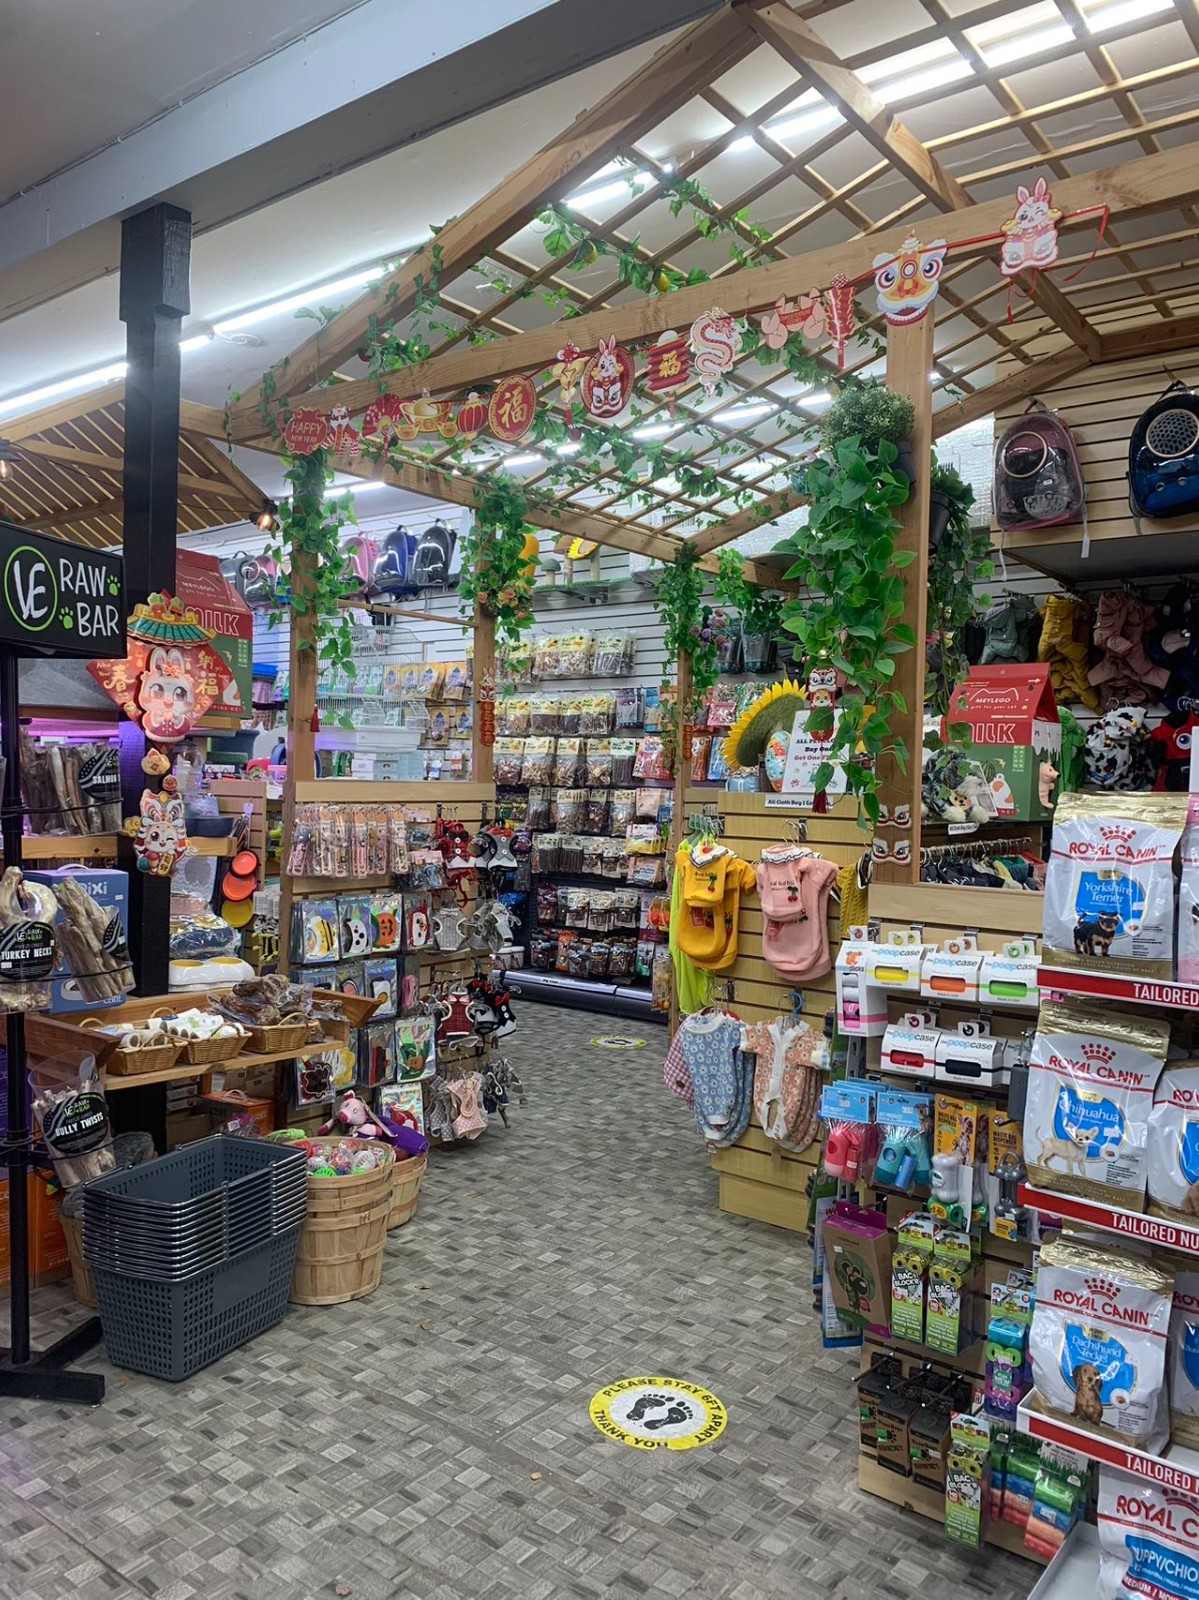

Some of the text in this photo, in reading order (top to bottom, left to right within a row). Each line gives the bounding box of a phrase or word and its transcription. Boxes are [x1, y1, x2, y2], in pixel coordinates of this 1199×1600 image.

[498, 390, 524, 428] 福
[291, 421, 322, 435] HAPPY
[60, 558, 106, 597] RAW
[76, 602, 119, 637] BAR
[103, 664, 135, 692] 春
[1069, 842, 1158, 859] ROYAL CANIN
[1084, 881, 1133, 895] Yorkshire
[0, 947, 52, 960] TURKEY NECKS
[933, 957, 978, 969] poopcase
[1133, 983, 1199, 1006] TAILORED
[893, 1030, 935, 1043] poopcase
[947, 1039, 993, 1051] poopcase
[1049, 1055, 1143, 1086] ROYAL CANIN
[1060, 1100, 1119, 1121] Chihuahua
[55, 1112, 104, 1137] BULLY TWISTS
[1112, 1213, 1176, 1243] TAILORED
[1054, 1289, 1150, 1325] ROYAL CANIN
[1072, 1336, 1121, 1357] Dachshund
[1081, 1346, 1109, 1363] Teckel
[602, 1378, 723, 1443] PLEASE STAY 6FT APART
[593, 1410, 627, 1441] THANK
[1125, 1453, 1191, 1489] TAILORED
[1117, 1494, 1176, 1532] ROYAL
